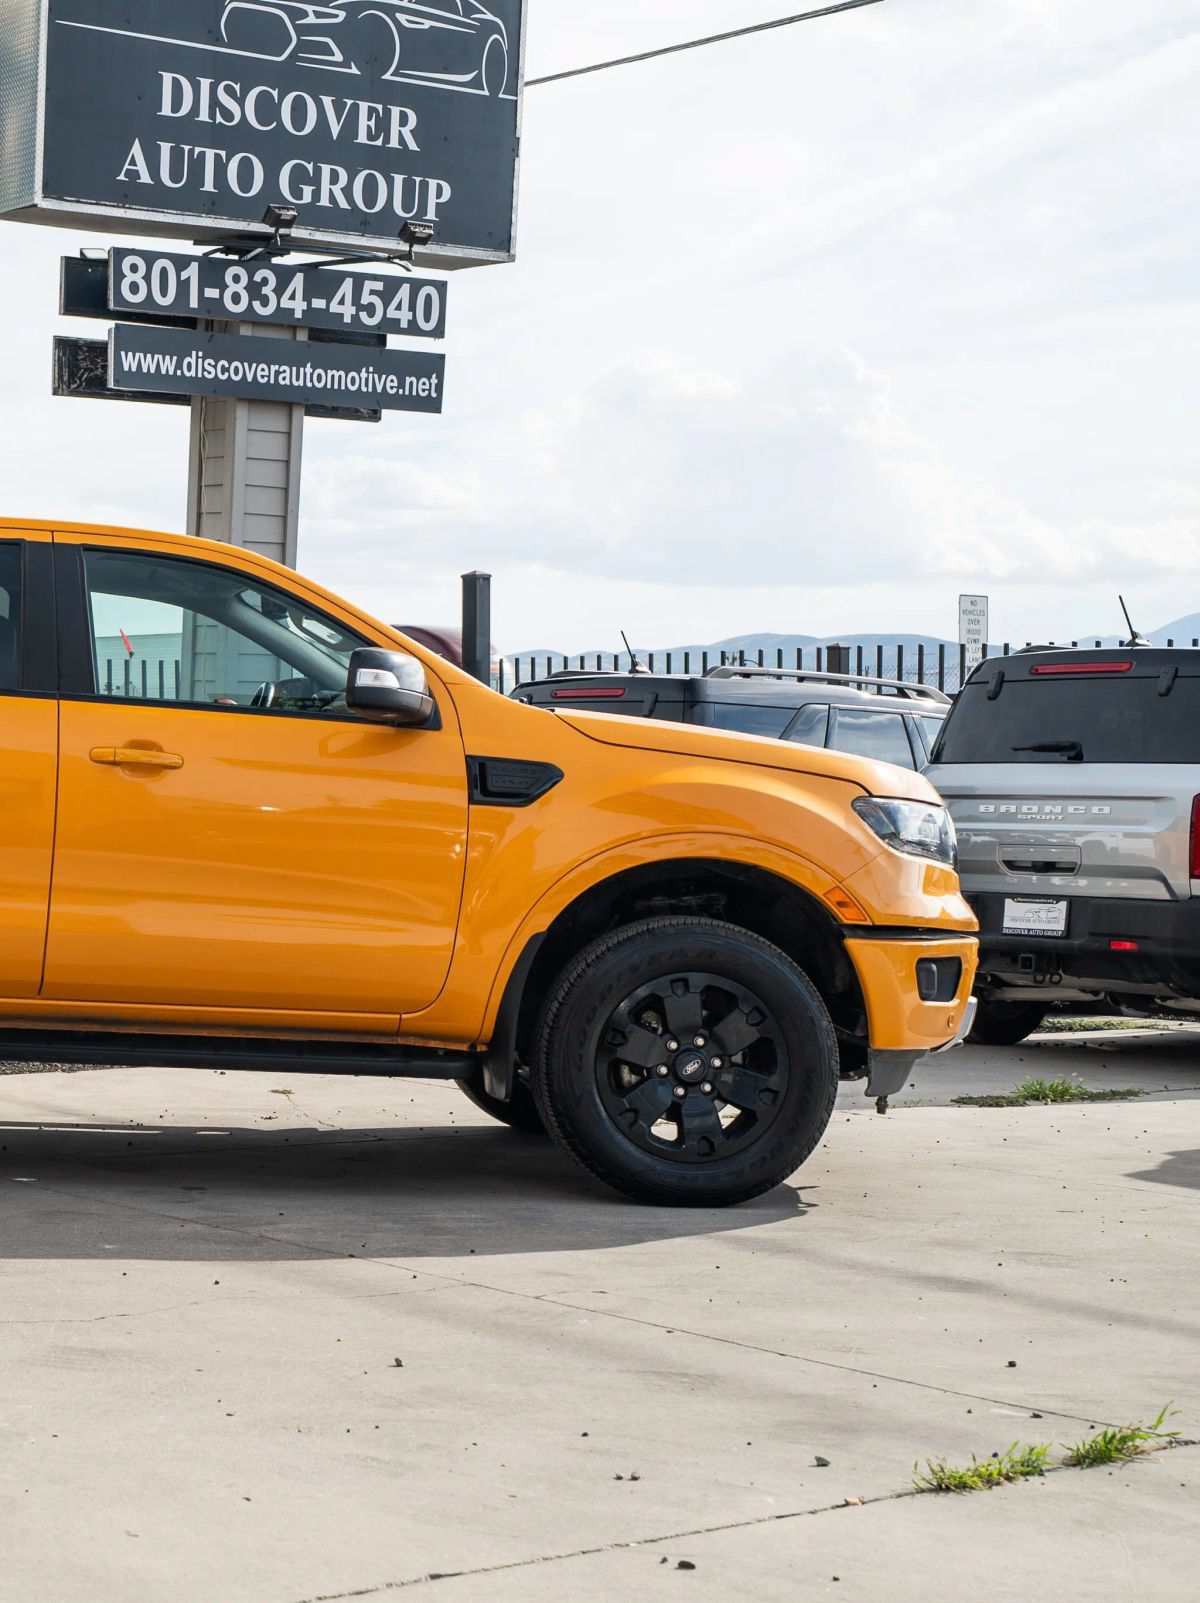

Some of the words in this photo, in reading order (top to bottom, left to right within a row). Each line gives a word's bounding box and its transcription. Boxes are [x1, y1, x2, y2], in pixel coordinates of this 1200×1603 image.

[157, 71, 420, 151] DISCOVER
[116, 137, 264, 197] AUTO
[279, 159, 452, 221] GROUP
[120, 255, 440, 332] 801-834-4540
[120, 350, 438, 398] www.discoverautomotive.net
[979, 804, 1111, 814] BRONCO
